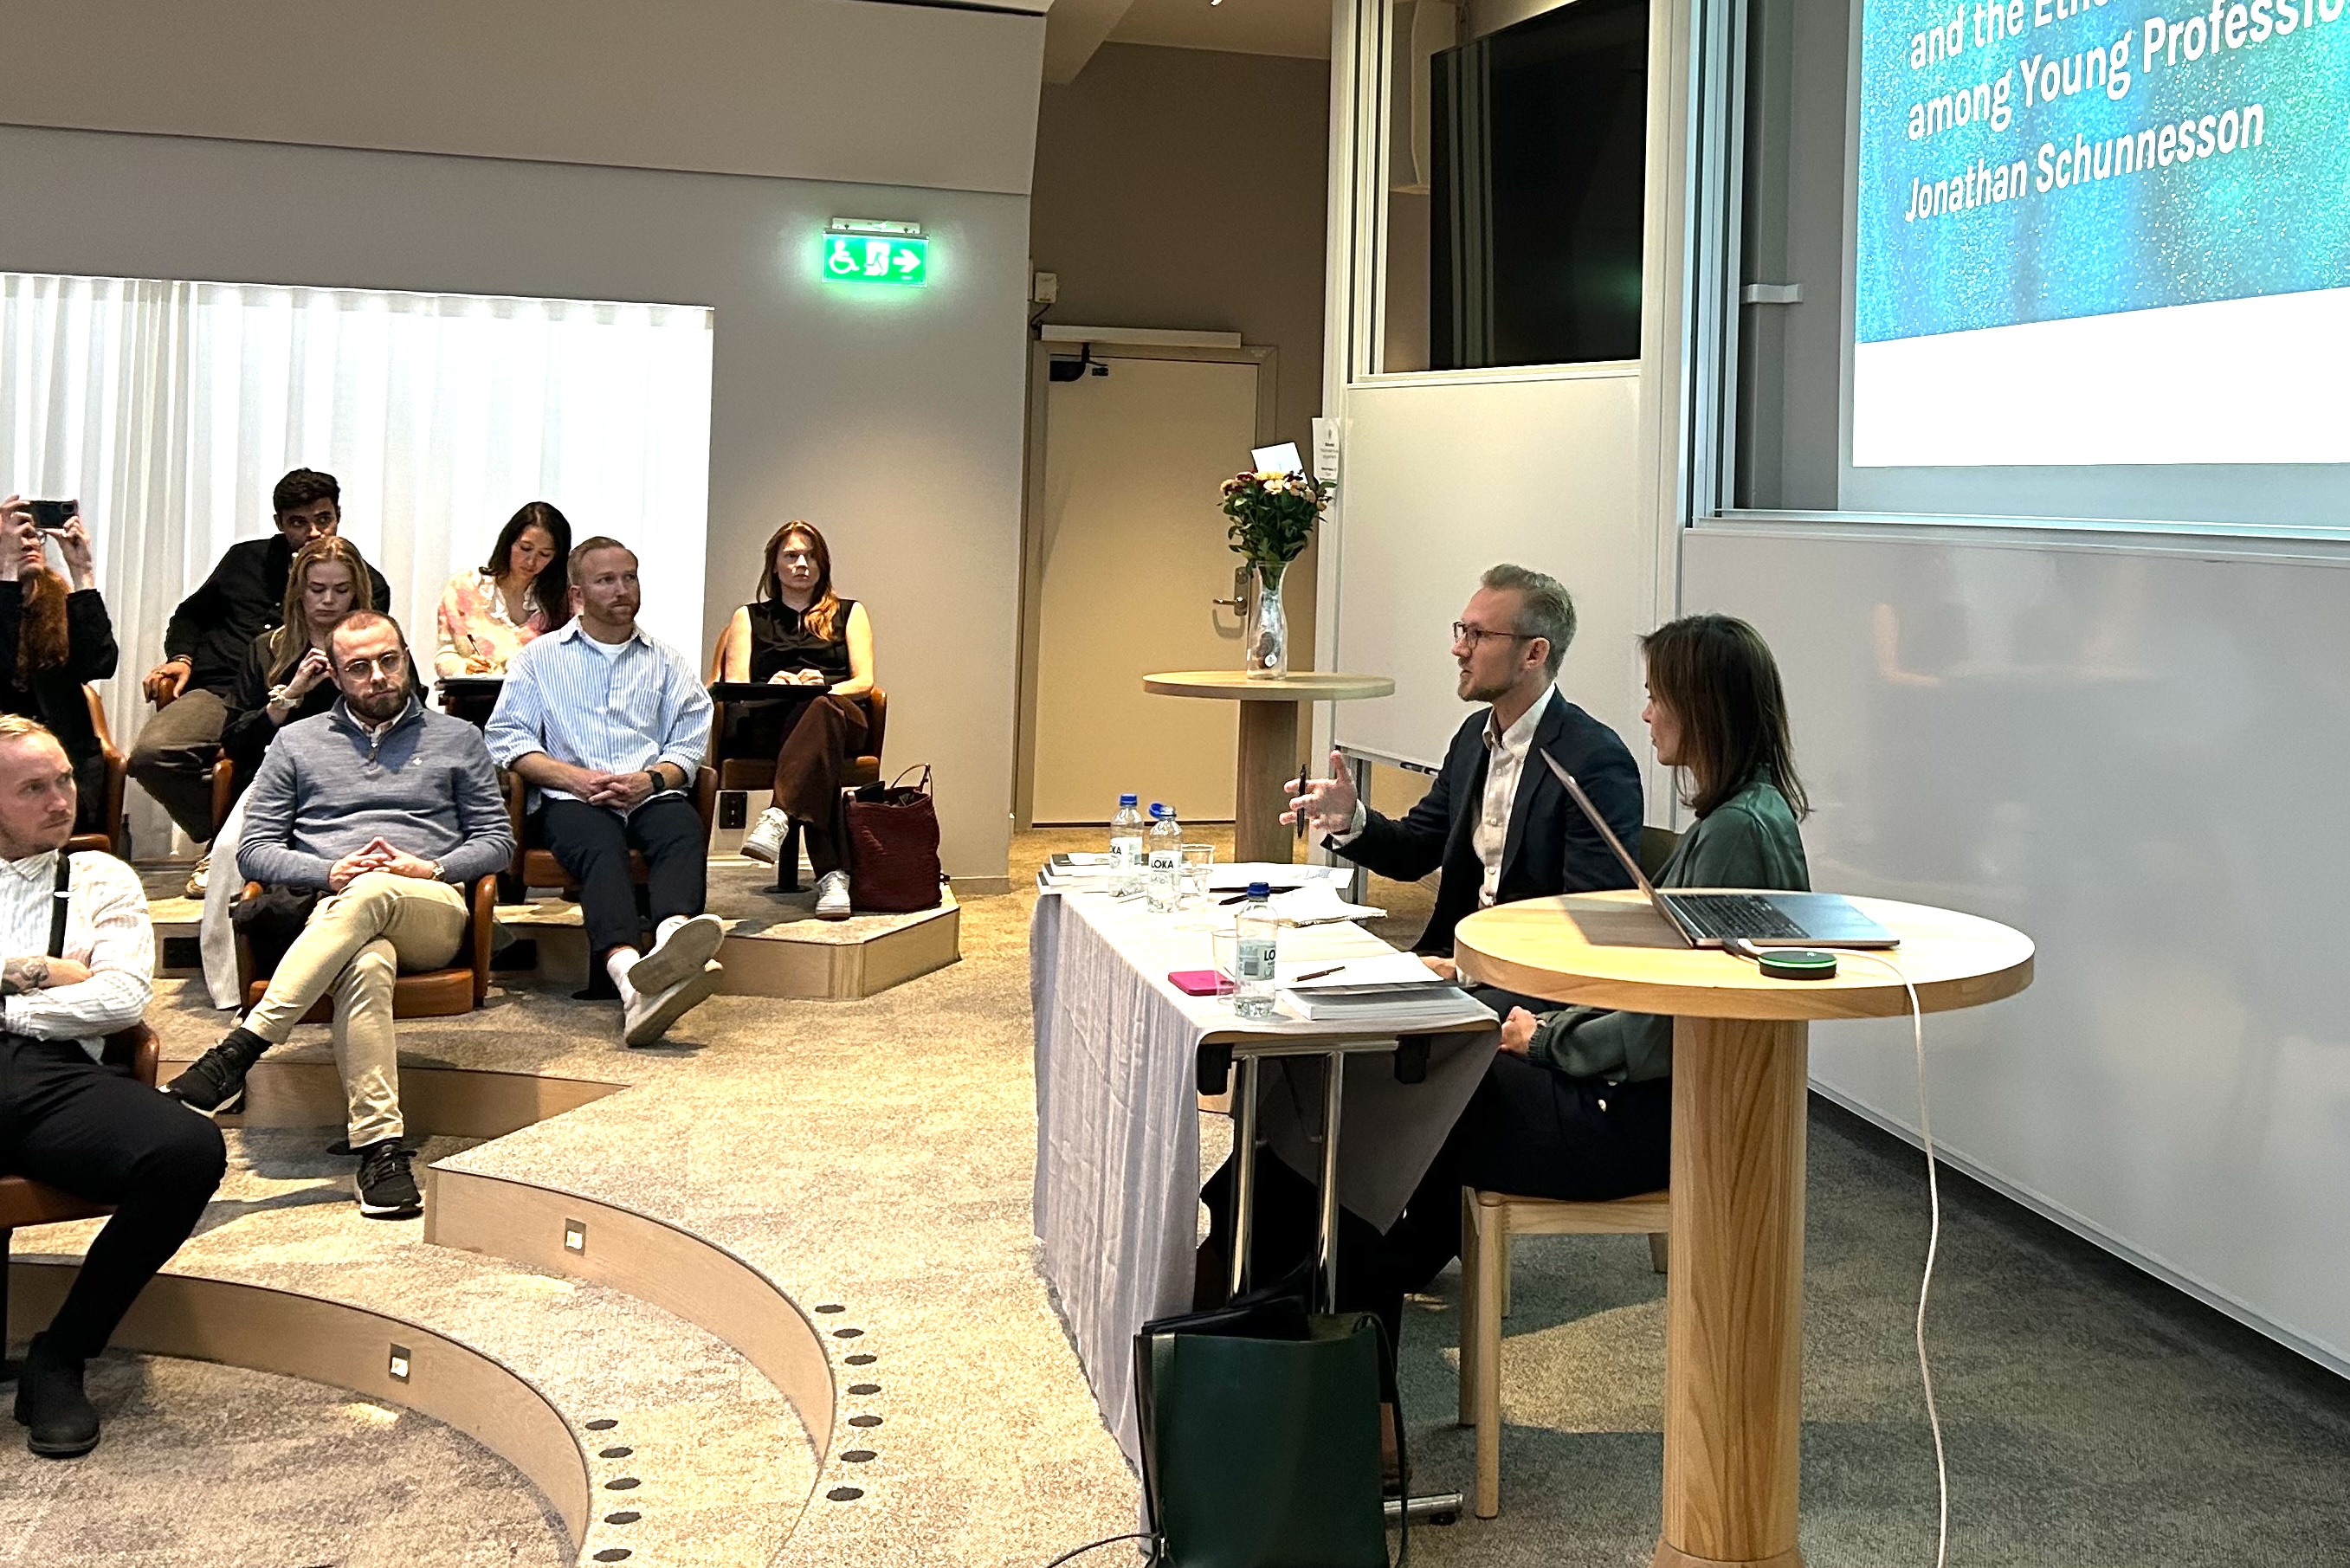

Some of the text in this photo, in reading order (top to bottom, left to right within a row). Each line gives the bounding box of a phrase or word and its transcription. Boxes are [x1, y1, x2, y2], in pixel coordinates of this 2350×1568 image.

[1910, 3, 1964, 70] and
[1972, 0, 2024, 48] the
[1908, 68, 2012, 140] among
[2019, 29, 2132, 107] Young
[1905, 103, 2264, 223] Jonathan Schunnesson
[1151, 860, 1174, 869] LOKA
